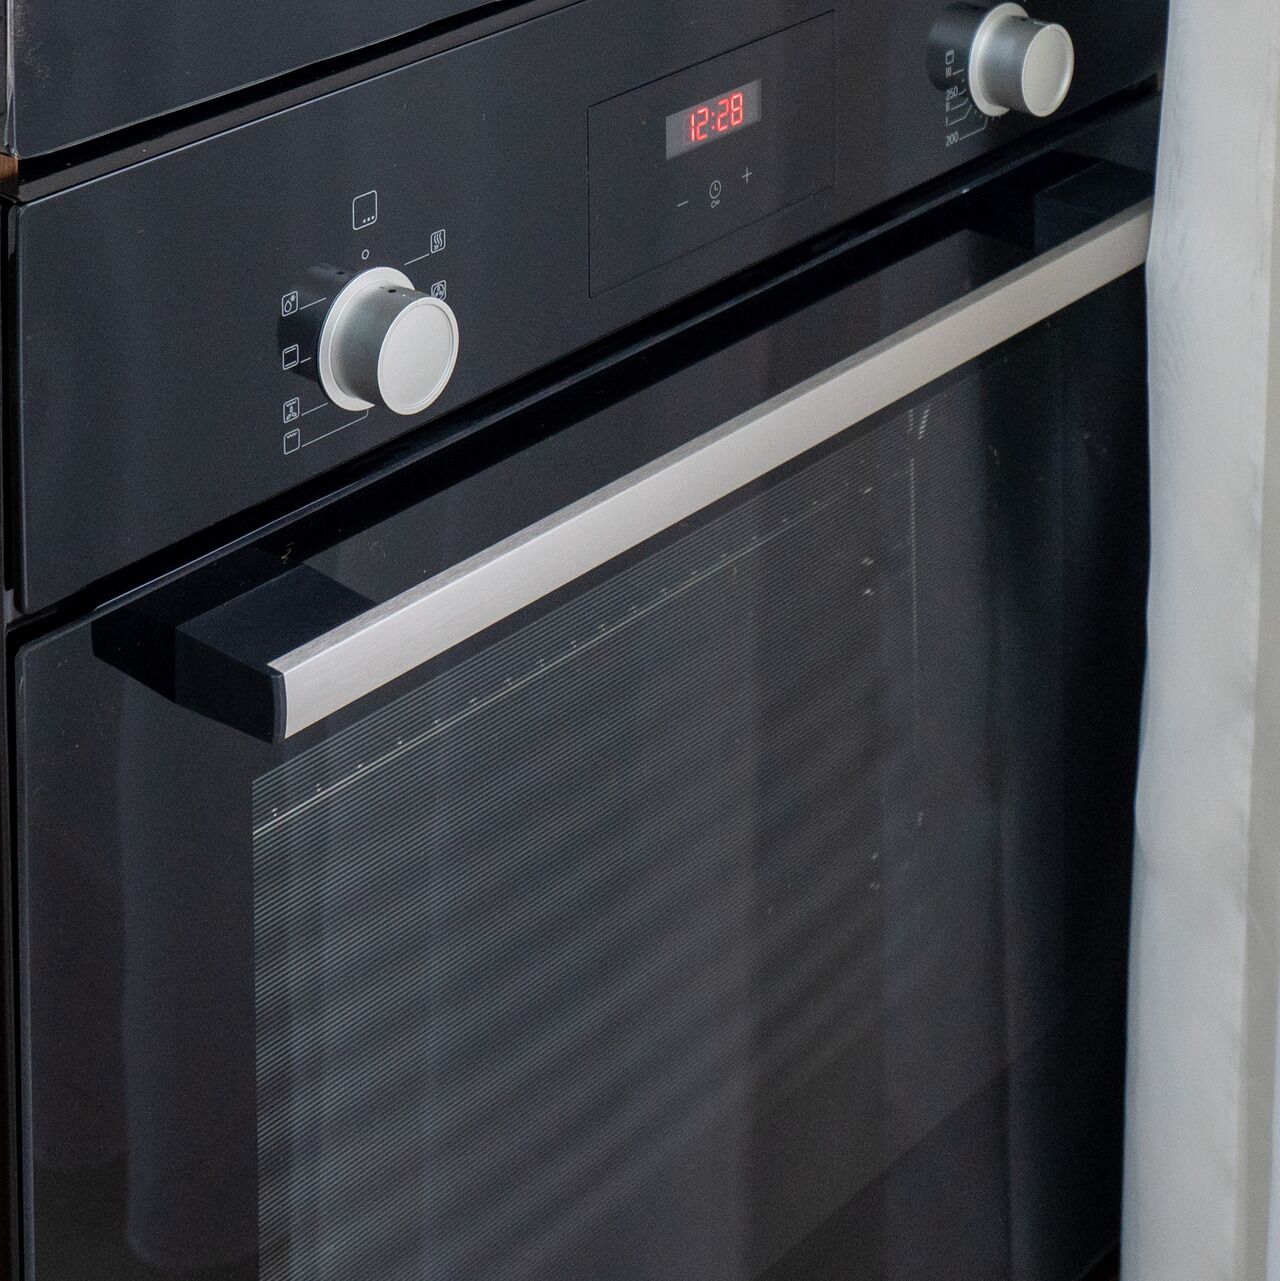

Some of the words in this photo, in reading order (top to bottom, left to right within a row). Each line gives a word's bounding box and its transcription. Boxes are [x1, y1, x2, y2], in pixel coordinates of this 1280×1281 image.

[946, 86, 958, 101] 250
[690, 93, 743, 142] 12:28
[946, 131, 958, 147] 200
